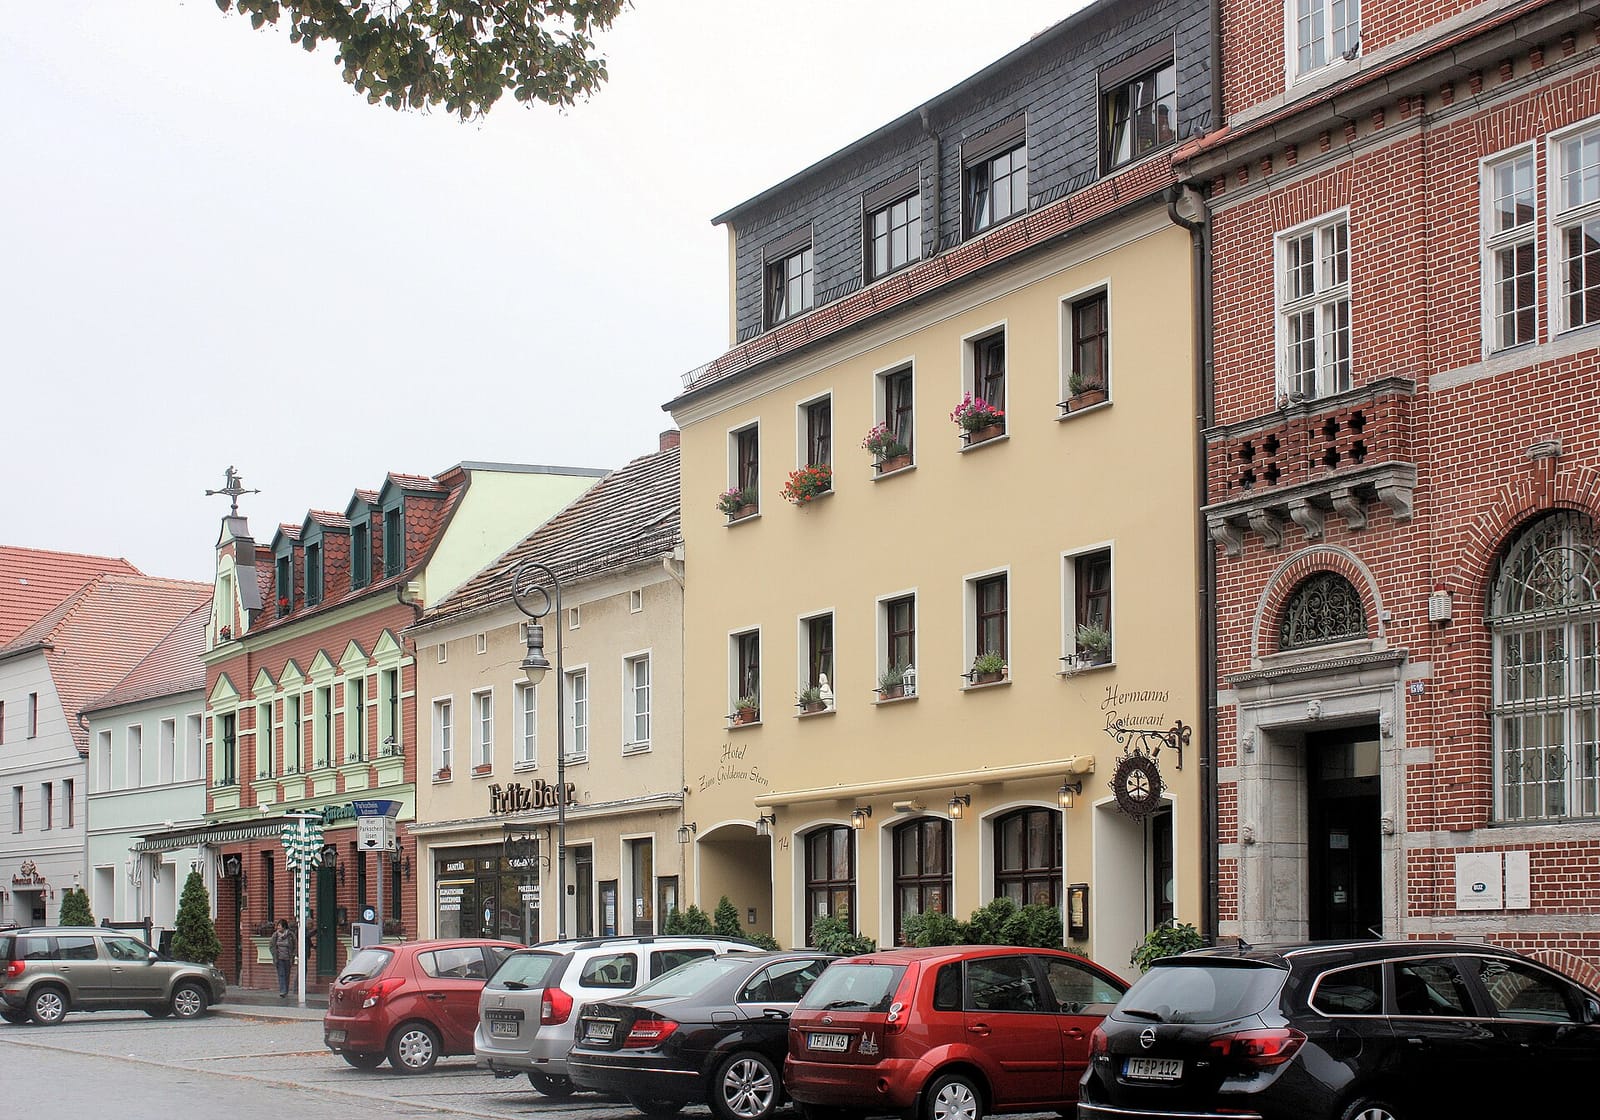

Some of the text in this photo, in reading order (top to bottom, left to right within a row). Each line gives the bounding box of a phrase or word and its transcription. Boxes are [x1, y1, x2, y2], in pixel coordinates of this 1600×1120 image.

[1100, 683, 1170, 711] Hermanns
[720, 742, 747, 764] Hotel
[698, 764, 769, 793] Zum Goldenen Stern
[488, 778, 576, 814] Fritz Baer
[778, 836, 789, 851] 14
[447, 861, 464, 872] SANITÄR
[812, 1034, 845, 1048] TF IN 46
[1132, 1058, 1179, 1076] TF P 112
